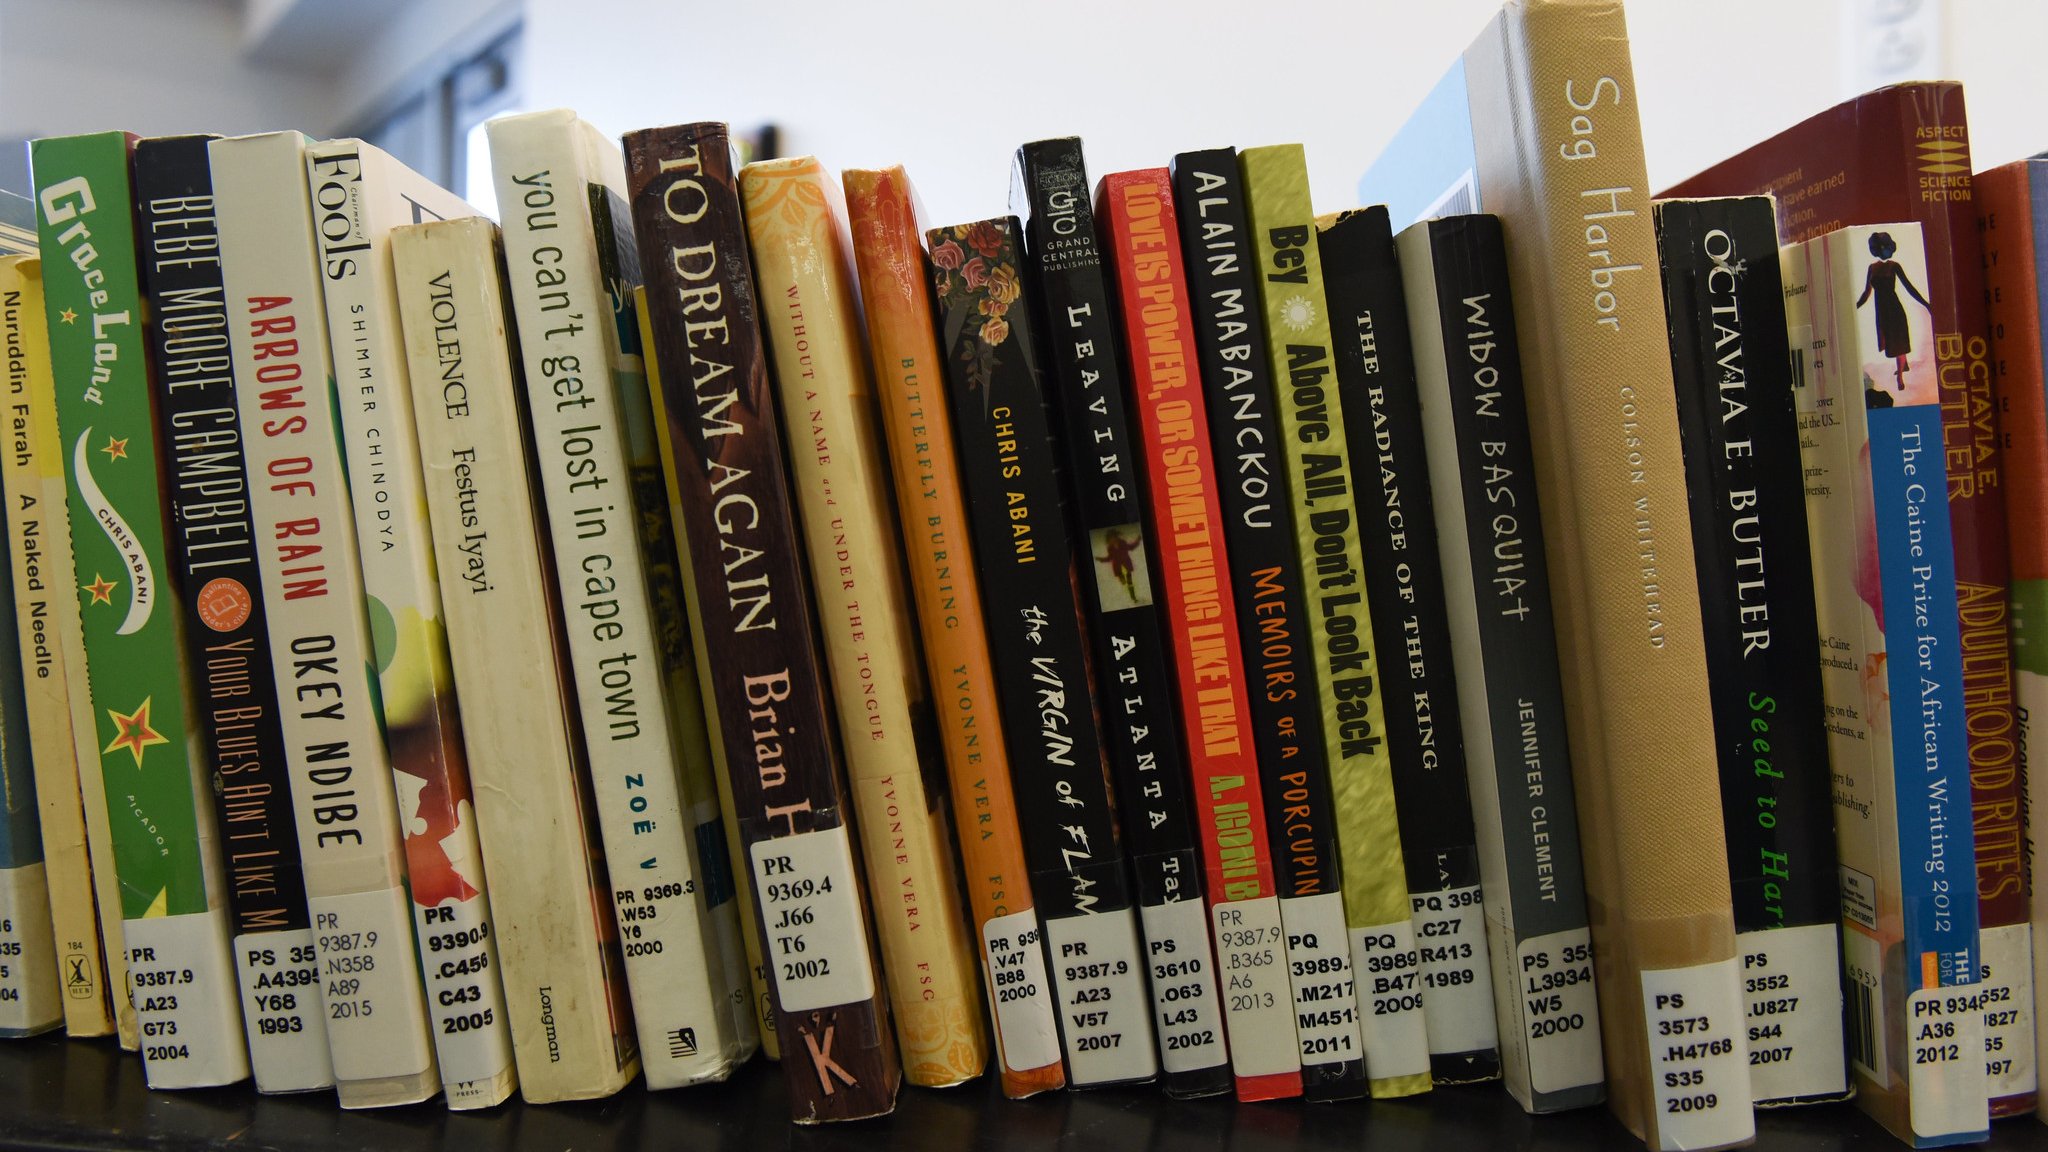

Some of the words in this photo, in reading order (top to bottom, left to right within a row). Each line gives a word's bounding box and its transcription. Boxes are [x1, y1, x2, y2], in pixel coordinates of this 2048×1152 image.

[1560, 76, 1621, 160] Sag
[1916, 126, 1965, 139] ASPECT
[511, 170, 559, 232] you
[1807, 170, 1845, 198] earned
[1919, 176, 1971, 188] SCIENCE
[1921, 190, 1972, 203] FICTION
[351, 187, 360, 228] Chairman
[1123, 183, 1166, 250] LOVE
[1193, 171, 1239, 276] ALAIN
[150, 194, 221, 274] BEBE
[1047, 237, 1090, 250] GRAND
[1042, 248, 1100, 262] CENTRAL
[1044, 258, 1101, 272] PUBLISHING
[1580, 186, 1642, 331] Harbor
[532, 246, 584, 341] can't
[3, 290, 25, 395] Nuruddin
[159, 286, 233, 396] MOORE
[428, 269, 470, 421] VIOLENCE
[673, 241, 744, 440] DREAM
[1357, 310, 1379, 375] THE
[1704, 229, 1749, 426] OCTAVIA
[247, 295, 309, 438] ARROWS
[540, 354, 597, 413] get
[1211, 288, 1271, 527] MABANCKOU
[1286, 343, 1330, 443] Above
[1967, 336, 1995, 464] OCTAVIA
[12, 403, 30, 468] Farah
[350, 304, 376, 413] SHIMMER
[366, 428, 395, 553] CHINODYA
[1935, 333, 1975, 502] BUTLER
[561, 425, 609, 494] lost
[993, 406, 1021, 479] CHRIS
[1901, 424, 1922, 476] The
[267, 456, 316, 499] OF
[452, 446, 481, 528] Festus
[1368, 386, 1406, 549] RADIANCE
[172, 406, 252, 576] CAMPBELL
[574, 505, 615, 540] in
[1006, 491, 1036, 564] ABANI
[1162, 445, 1222, 621] SOMETHING
[1620, 386, 1646, 483] COLSON
[1634, 496, 1665, 649] WHITEHEAD
[1906, 484, 1926, 557] Caine
[23, 519, 44, 591] Naked
[275, 517, 328, 601] RAIN
[457, 530, 494, 595] Iyayi
[707, 458, 776, 633] AGAIN
[1309, 508, 1351, 590] Don't
[1068, 303, 1125, 502] LEAVING
[1111, 636, 1167, 829] ATLANTA
[1396, 563, 1414, 603] OF
[1729, 489, 1771, 660] BUTLER
[580, 554, 624, 643] cape
[786, 284, 815, 380] WITHOUT
[810, 410, 831, 466] NAME
[823, 478, 836, 506] and
[831, 518, 854, 590] UNDER
[847, 600, 864, 642] THE
[857, 652, 884, 741] TONGUE
[881, 775, 908, 865] YVONNE
[901, 877, 921, 932] VERA
[901, 357, 937, 500] BUTTERFLY
[927, 515, 959, 629] BURNING
[953, 665, 981, 765] YVONNE
[973, 779, 993, 841] VERA
[1912, 564, 1932, 628] Prize
[31, 600, 49, 679] Needle
[1188, 622, 1230, 684] LIKE
[1252, 566, 1296, 702] MEMOIRS
[1321, 593, 1369, 675] Look
[1404, 616, 1425, 679] THE
[1918, 635, 1938, 671] for
[205, 638, 255, 699] YOUR
[290, 634, 346, 721] OKEY
[1956, 580, 2016, 790] ADULTHOOD
[598, 652, 642, 742] town
[1030, 656, 1076, 767] VIRGIN
[744, 667, 797, 790] Brian
[1198, 683, 1241, 758] THAT
[1332, 675, 1384, 760] Back
[1414, 691, 1438, 771] KING
[1749, 692, 1784, 778] Seed
[1920, 677, 1942, 772] African
[213, 705, 263, 776] BLUES
[223, 783, 272, 841] AIN'T
[305, 741, 363, 849] NDIBE
[1518, 698, 1543, 797] JENNIFER
[1531, 807, 1556, 903] CLEMENT
[127, 795, 169, 857] PICADOR
[1213, 802, 1258, 879] IGONI
[1925, 775, 1950, 873] Writing
[764, 856, 795, 875] PR
[1971, 797, 2023, 900] RITES
[232, 850, 280, 899] LIKE
[768, 877, 833, 902] 9369.4
[424, 906, 456, 925] PR
[616, 890, 635, 904] PR
[1412, 896, 1443, 912] PQ
[1933, 880, 1952, 933] 2012
[317, 913, 338, 930] PR
[774, 906, 815, 929] .J66
[1220, 910, 1242, 926] PR
[1222, 927, 1280, 948] 9387.9
[1416, 920, 1461, 938] .C27
[132, 947, 156, 962] PR
[249, 949, 276, 967] PS
[319, 932, 378, 953] 9387.9
[626, 940, 663, 957] 2000
[778, 936, 806, 955] T6
[990, 938, 1009, 953] PR
[1062, 942, 1088, 958] PR
[1151, 940, 1176, 955] PS
[1226, 950, 1273, 970] .B365
[1288, 934, 1318, 950] PQ
[1364, 934, 1395, 951] PQ
[1421, 943, 1472, 963] R413
[1523, 952, 1549, 972] PS
[1745, 954, 1767, 968] PS
[136, 969, 194, 987] 9387.9
[324, 955, 375, 976] .N358
[784, 959, 831, 981] 2002
[1065, 960, 1128, 981] 9387.9
[1154, 960, 1201, 979] 3610
[1229, 973, 1252, 990] A6
[1425, 969, 1474, 988] 1989
[1746, 975, 1789, 993] 3552
[140, 997, 178, 1012] .A23
[255, 994, 297, 1012] Y68
[328, 979, 360, 997] A89
[438, 985, 482, 1007] C43
[1000, 984, 1036, 1003] 2000
[1070, 988, 1112, 1005] .A23
[1231, 992, 1275, 1011] 2013
[1529, 995, 1562, 1016] W5
[1656, 994, 1684, 1009] PS
[143, 1021, 177, 1036] G73
[258, 1016, 303, 1035] 1993
[331, 1000, 372, 1019] 2015
[442, 1008, 494, 1034] 2005
[539, 986, 560, 1064] Longman
[1072, 1011, 1109, 1028] V57
[1163, 1009, 1198, 1026] L43
[1531, 1014, 1584, 1038] 2000
[1659, 1017, 1709, 1036] 3573
[1915, 1000, 1941, 1017] PR
[1077, 1034, 1122, 1052] 2007
[1167, 1031, 1214, 1050] 2002
[1303, 1036, 1351, 1054] 2011
[1662, 1039, 1733, 1061] .H4768
[1749, 1024, 1782, 1041] S44
[1916, 1022, 1955, 1041] .A36
[147, 1044, 190, 1061] 2004
[1750, 1047, 1793, 1065] 2007
[1916, 1045, 1959, 1064] 2012
[1665, 1070, 1704, 1087] S35
[1667, 1094, 1718, 1113] 2009
